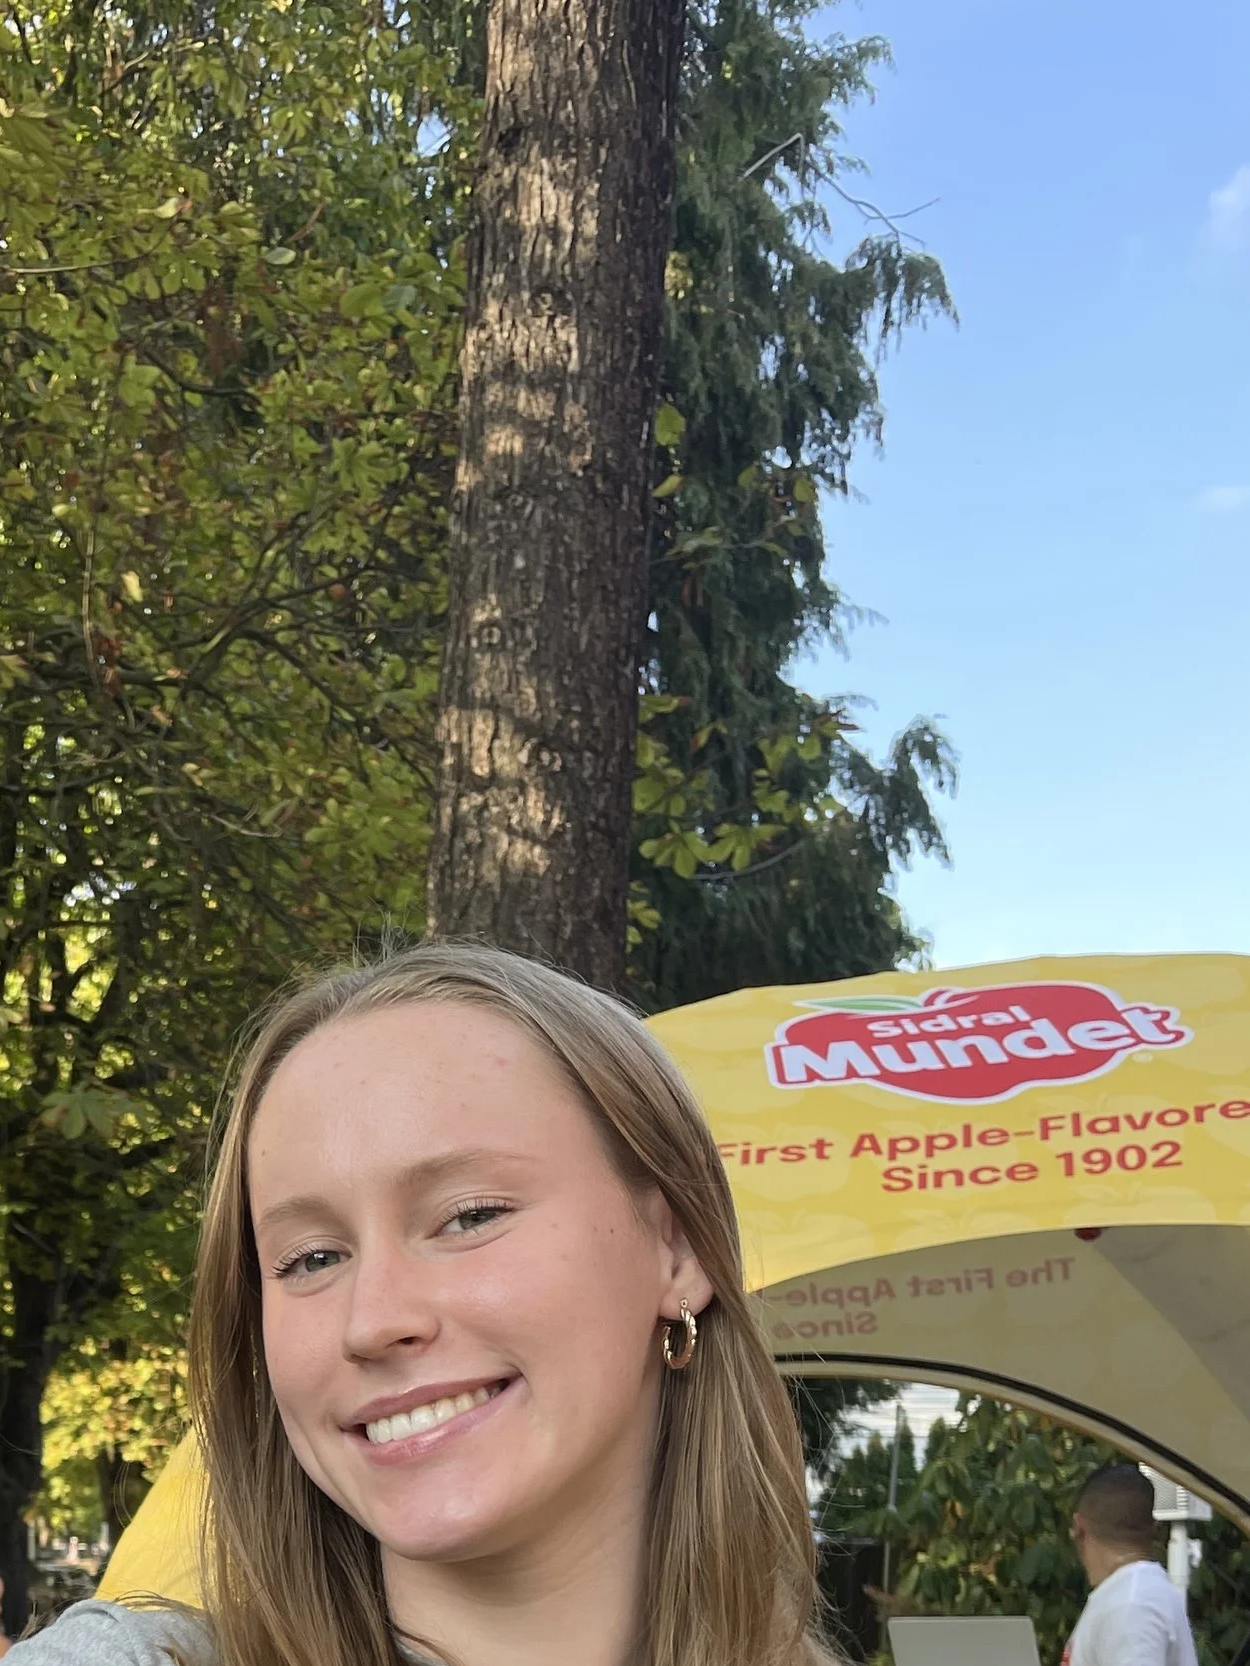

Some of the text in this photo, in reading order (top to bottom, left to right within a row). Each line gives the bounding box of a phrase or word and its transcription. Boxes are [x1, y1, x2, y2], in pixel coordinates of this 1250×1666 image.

[781, 1007, 1179, 1082] Mundet
[867, 1005, 1031, 1039] Sidral
[881, 1140, 1183, 1193] Since 1902
